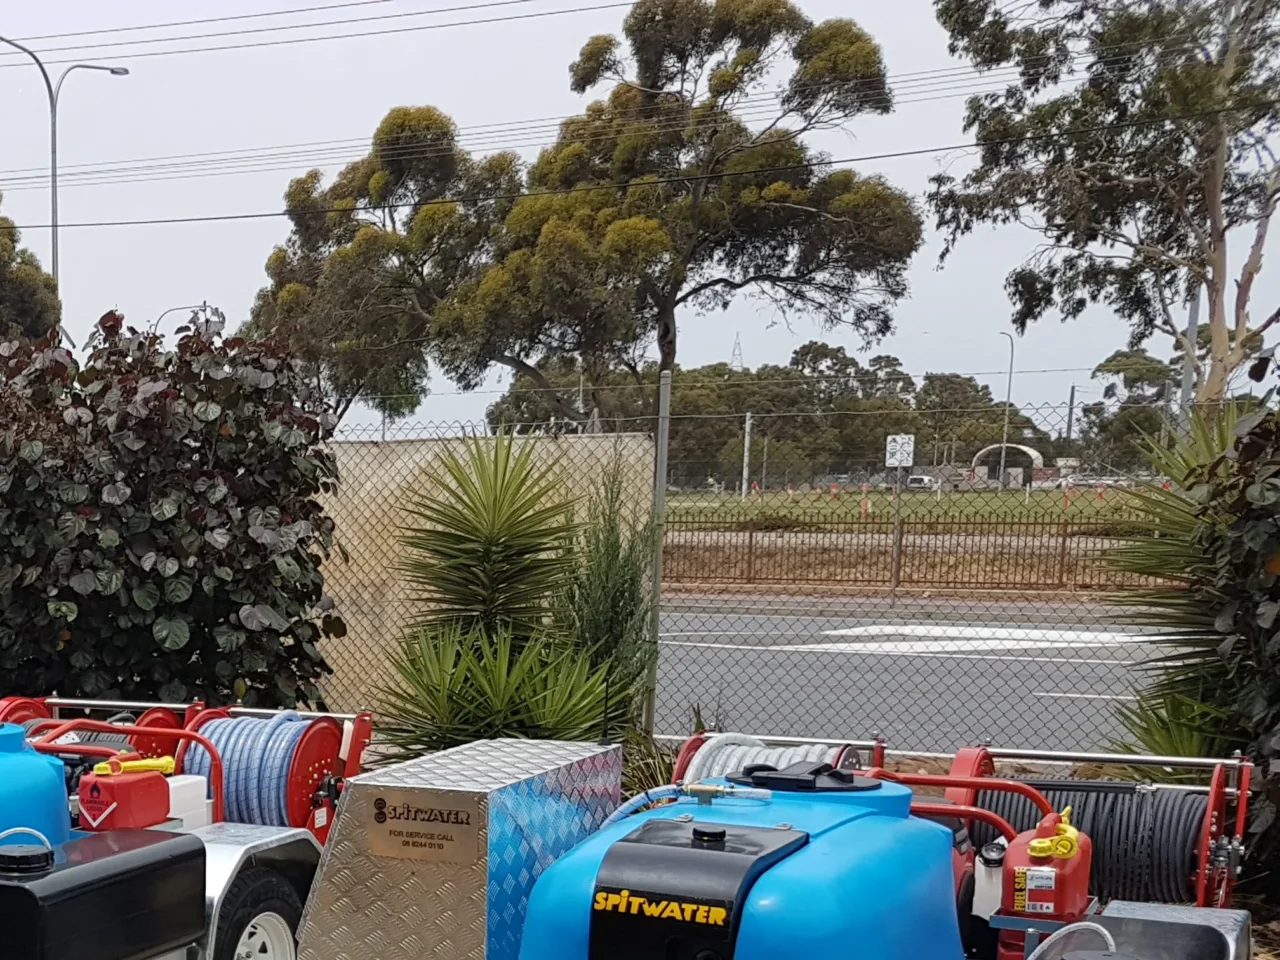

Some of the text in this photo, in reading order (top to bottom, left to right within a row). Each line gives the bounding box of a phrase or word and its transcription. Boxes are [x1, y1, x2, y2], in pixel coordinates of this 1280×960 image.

[389, 830, 455, 842] FOR SERVICE CALL
[428, 842, 444, 850] 0110
[1014, 868, 1026, 911] FUEL SAFE
